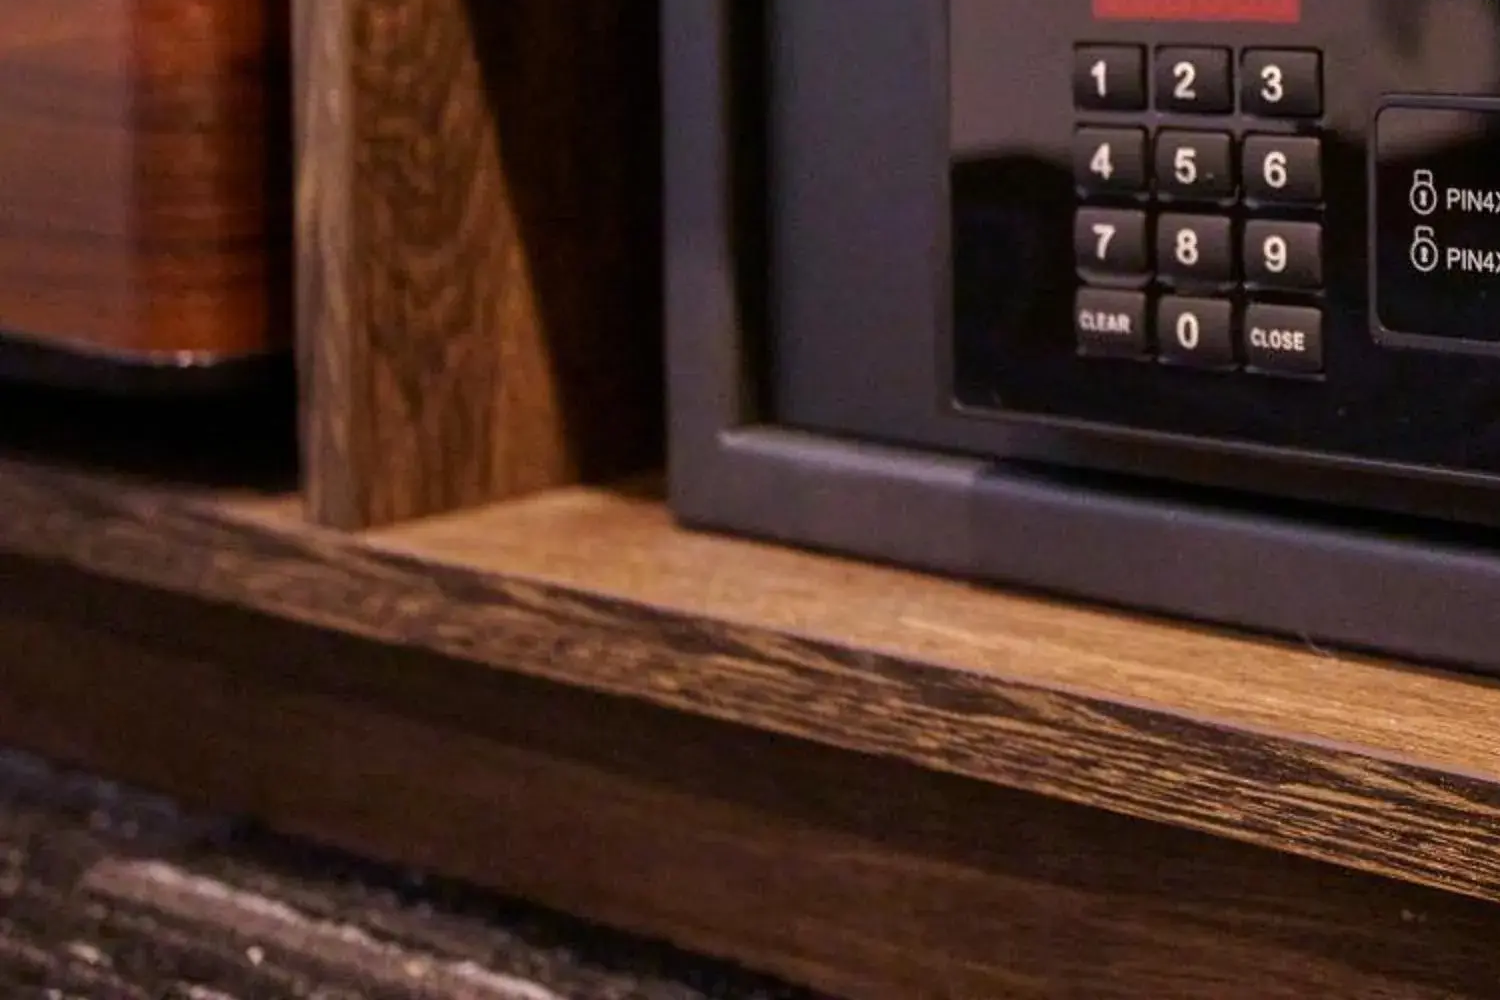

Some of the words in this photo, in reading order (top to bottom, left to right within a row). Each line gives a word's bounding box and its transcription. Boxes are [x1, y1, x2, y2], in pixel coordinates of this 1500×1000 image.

[1091, 60, 1107, 96] 1
[1173, 61, 1196, 98] 2
[1261, 64, 1283, 102] 3
[1090, 142, 1113, 179] 4
[1174, 147, 1197, 184] 5
[1263, 151, 1287, 188] 6
[1092, 223, 1116, 258] 7
[1175, 228, 1199, 265] 8
[1263, 235, 1287, 272] 9
[1079, 309, 1131, 333] CLEAR
[1176, 311, 1199, 349] 0
[1250, 327, 1305, 351] CLOSE
